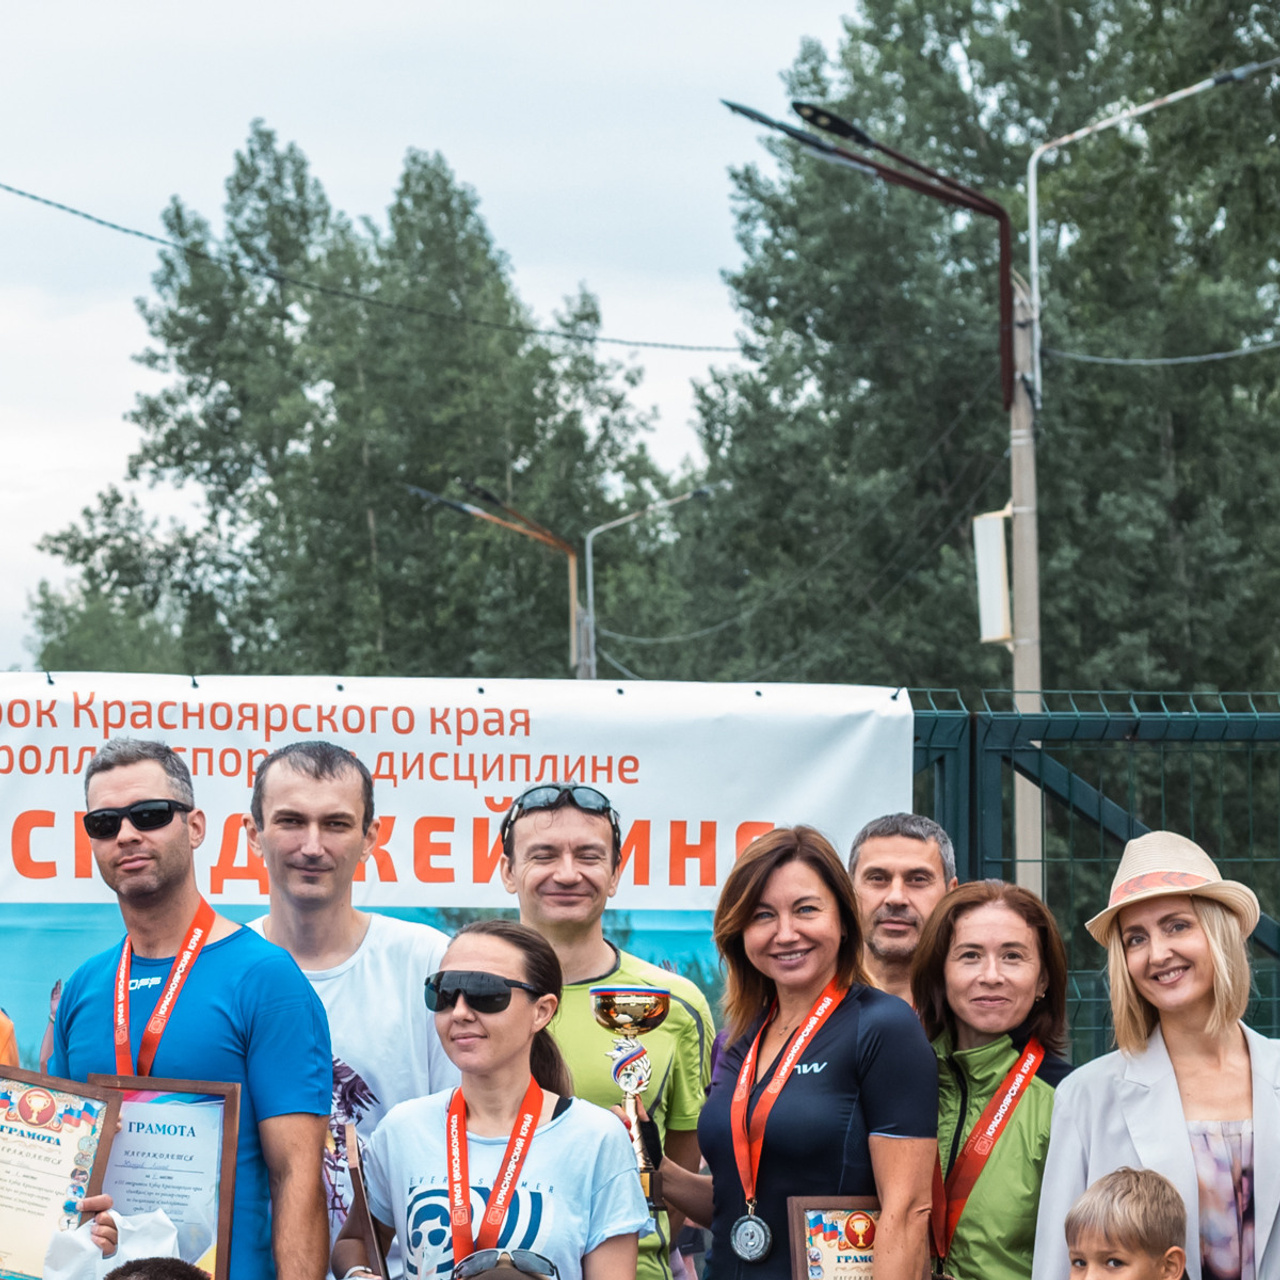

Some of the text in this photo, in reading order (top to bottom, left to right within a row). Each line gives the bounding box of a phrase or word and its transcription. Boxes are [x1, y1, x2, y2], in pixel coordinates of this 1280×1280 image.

[72, 691, 415, 743] Красноярского
[430, 706, 531, 747] края
[372, 751, 640, 789] дисциплине
[158, 928, 204, 1015] КРАСНОЯРСКИЙ КРАЙ
[779, 996, 833, 1077] КРАСНОЯРСКИЙ КРАЙ
[128, 1121, 196, 1138] ГРАМОТА
[986, 1052, 1036, 1137] КРАСНОЯРСКИЙ КРАЙ
[0, 1124, 62, 1147] ГРАМОТА
[451, 1114, 464, 1207] КРАСНОЯРСКИЙ КРАЙ
[496, 1113, 534, 1206] КРАСНОЯРСКИЙ КРАЙ
